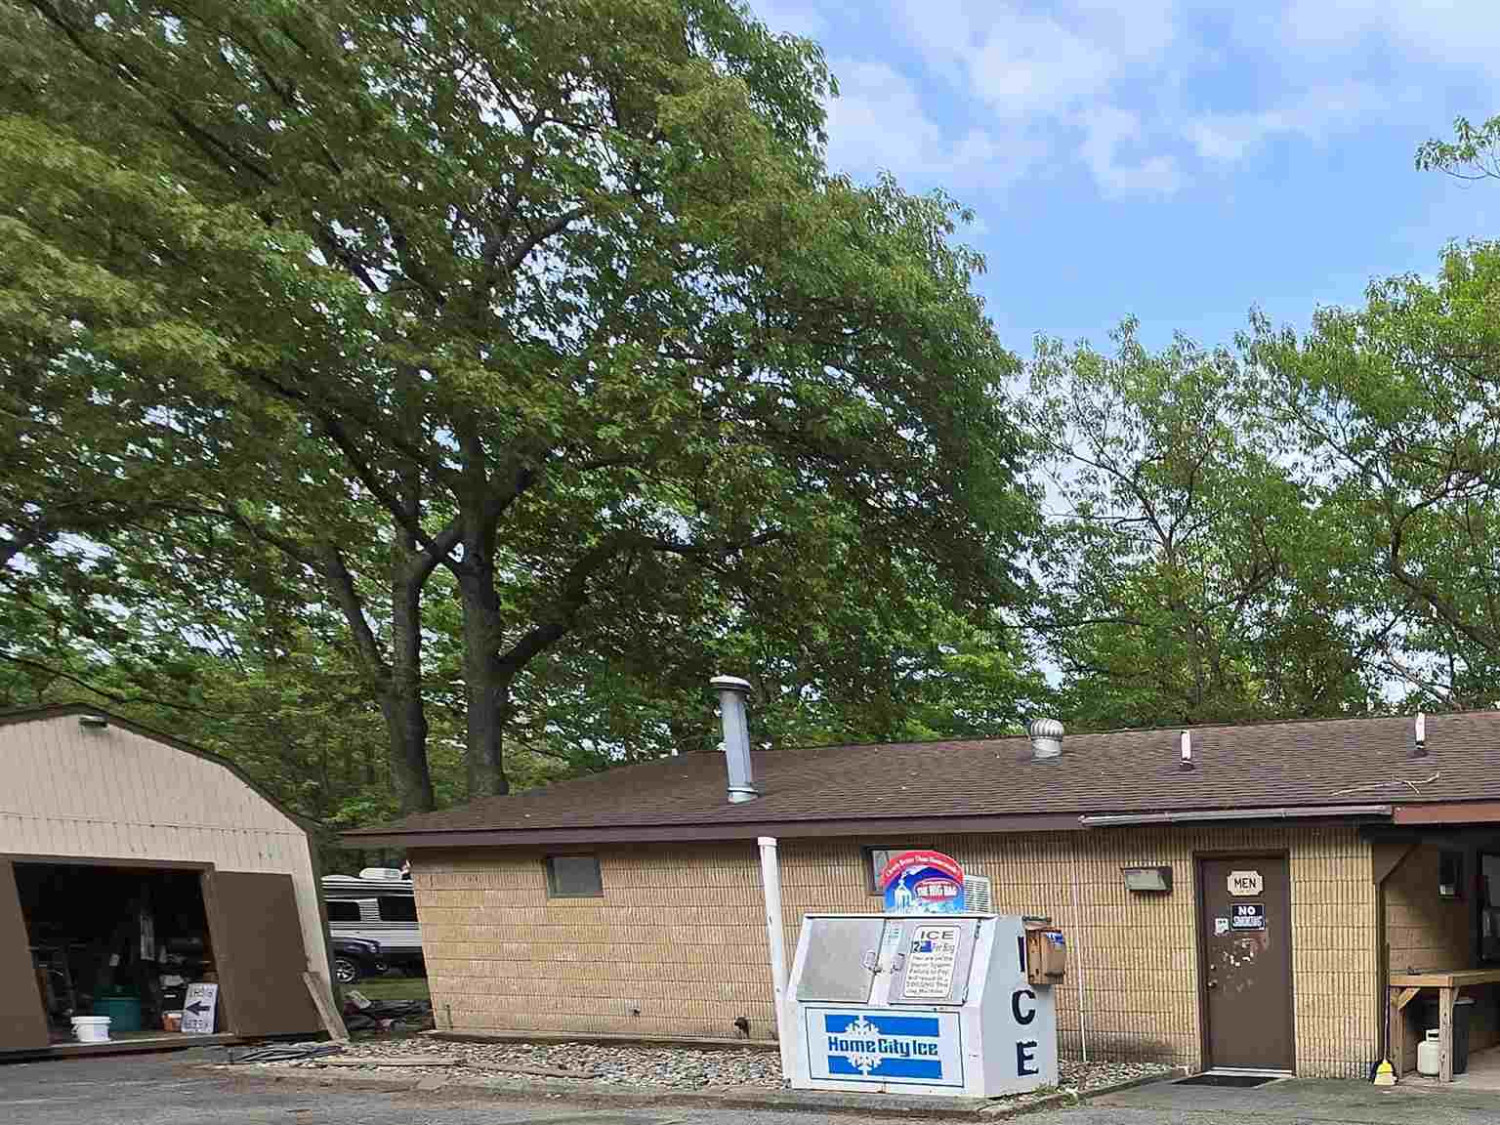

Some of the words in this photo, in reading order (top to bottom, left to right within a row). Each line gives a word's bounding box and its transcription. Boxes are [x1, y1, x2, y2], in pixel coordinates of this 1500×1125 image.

[1234, 877, 1256, 889] MEN
[1238, 905, 1256, 916] NO
[920, 930, 955, 941] ICE
[1011, 936, 1039, 1077] ICE
[827, 1036, 876, 1053] Home
[877, 1038, 911, 1057] City
[912, 1039, 939, 1056] Ice
